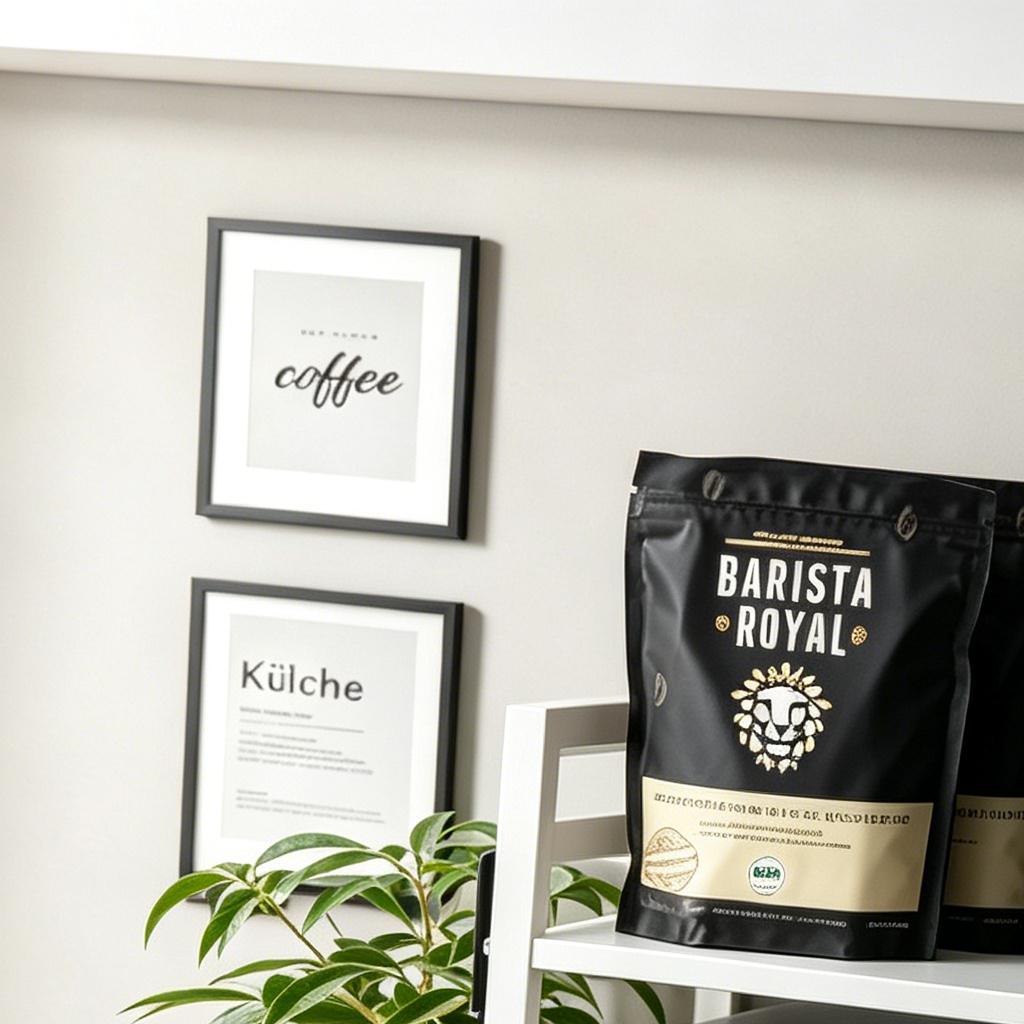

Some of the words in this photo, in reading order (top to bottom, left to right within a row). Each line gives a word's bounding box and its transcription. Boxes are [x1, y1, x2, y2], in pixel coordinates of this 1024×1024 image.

[274, 351, 403, 408] coffee
[717, 552, 872, 611] BARISTA
[735, 603, 846, 657] ROYAL
[241, 660, 364, 702] Külche
